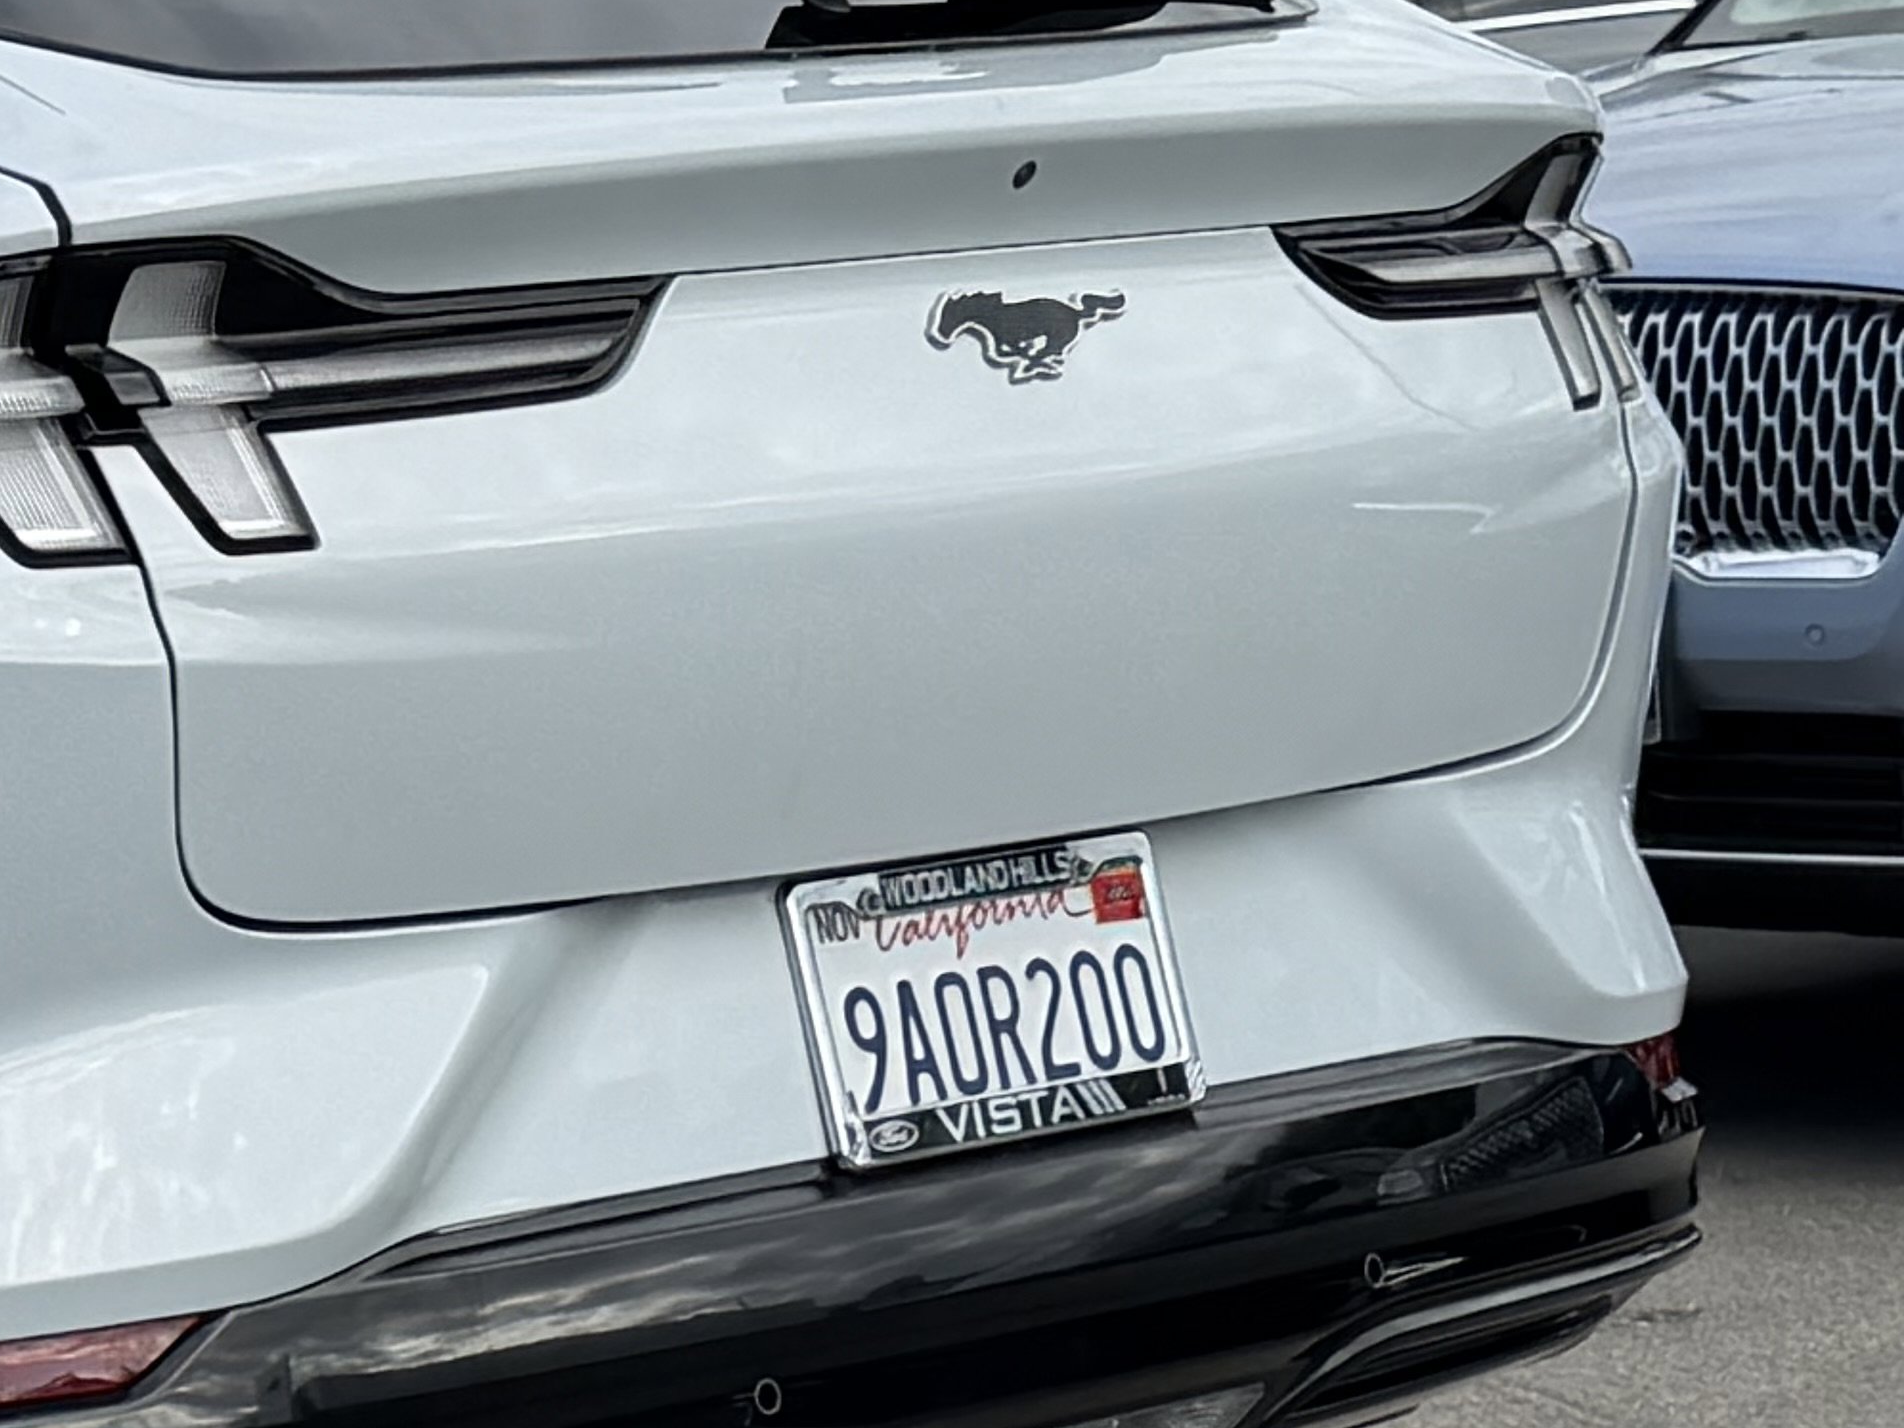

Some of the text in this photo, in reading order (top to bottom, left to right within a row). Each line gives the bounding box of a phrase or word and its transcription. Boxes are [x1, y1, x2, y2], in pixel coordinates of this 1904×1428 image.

[880, 850, 1073, 908] WOODLAND HILLS
[875, 888, 1072, 960] California
[843, 943, 1167, 1116] 9AOR200
[936, 1084, 1086, 1143] VISTA
